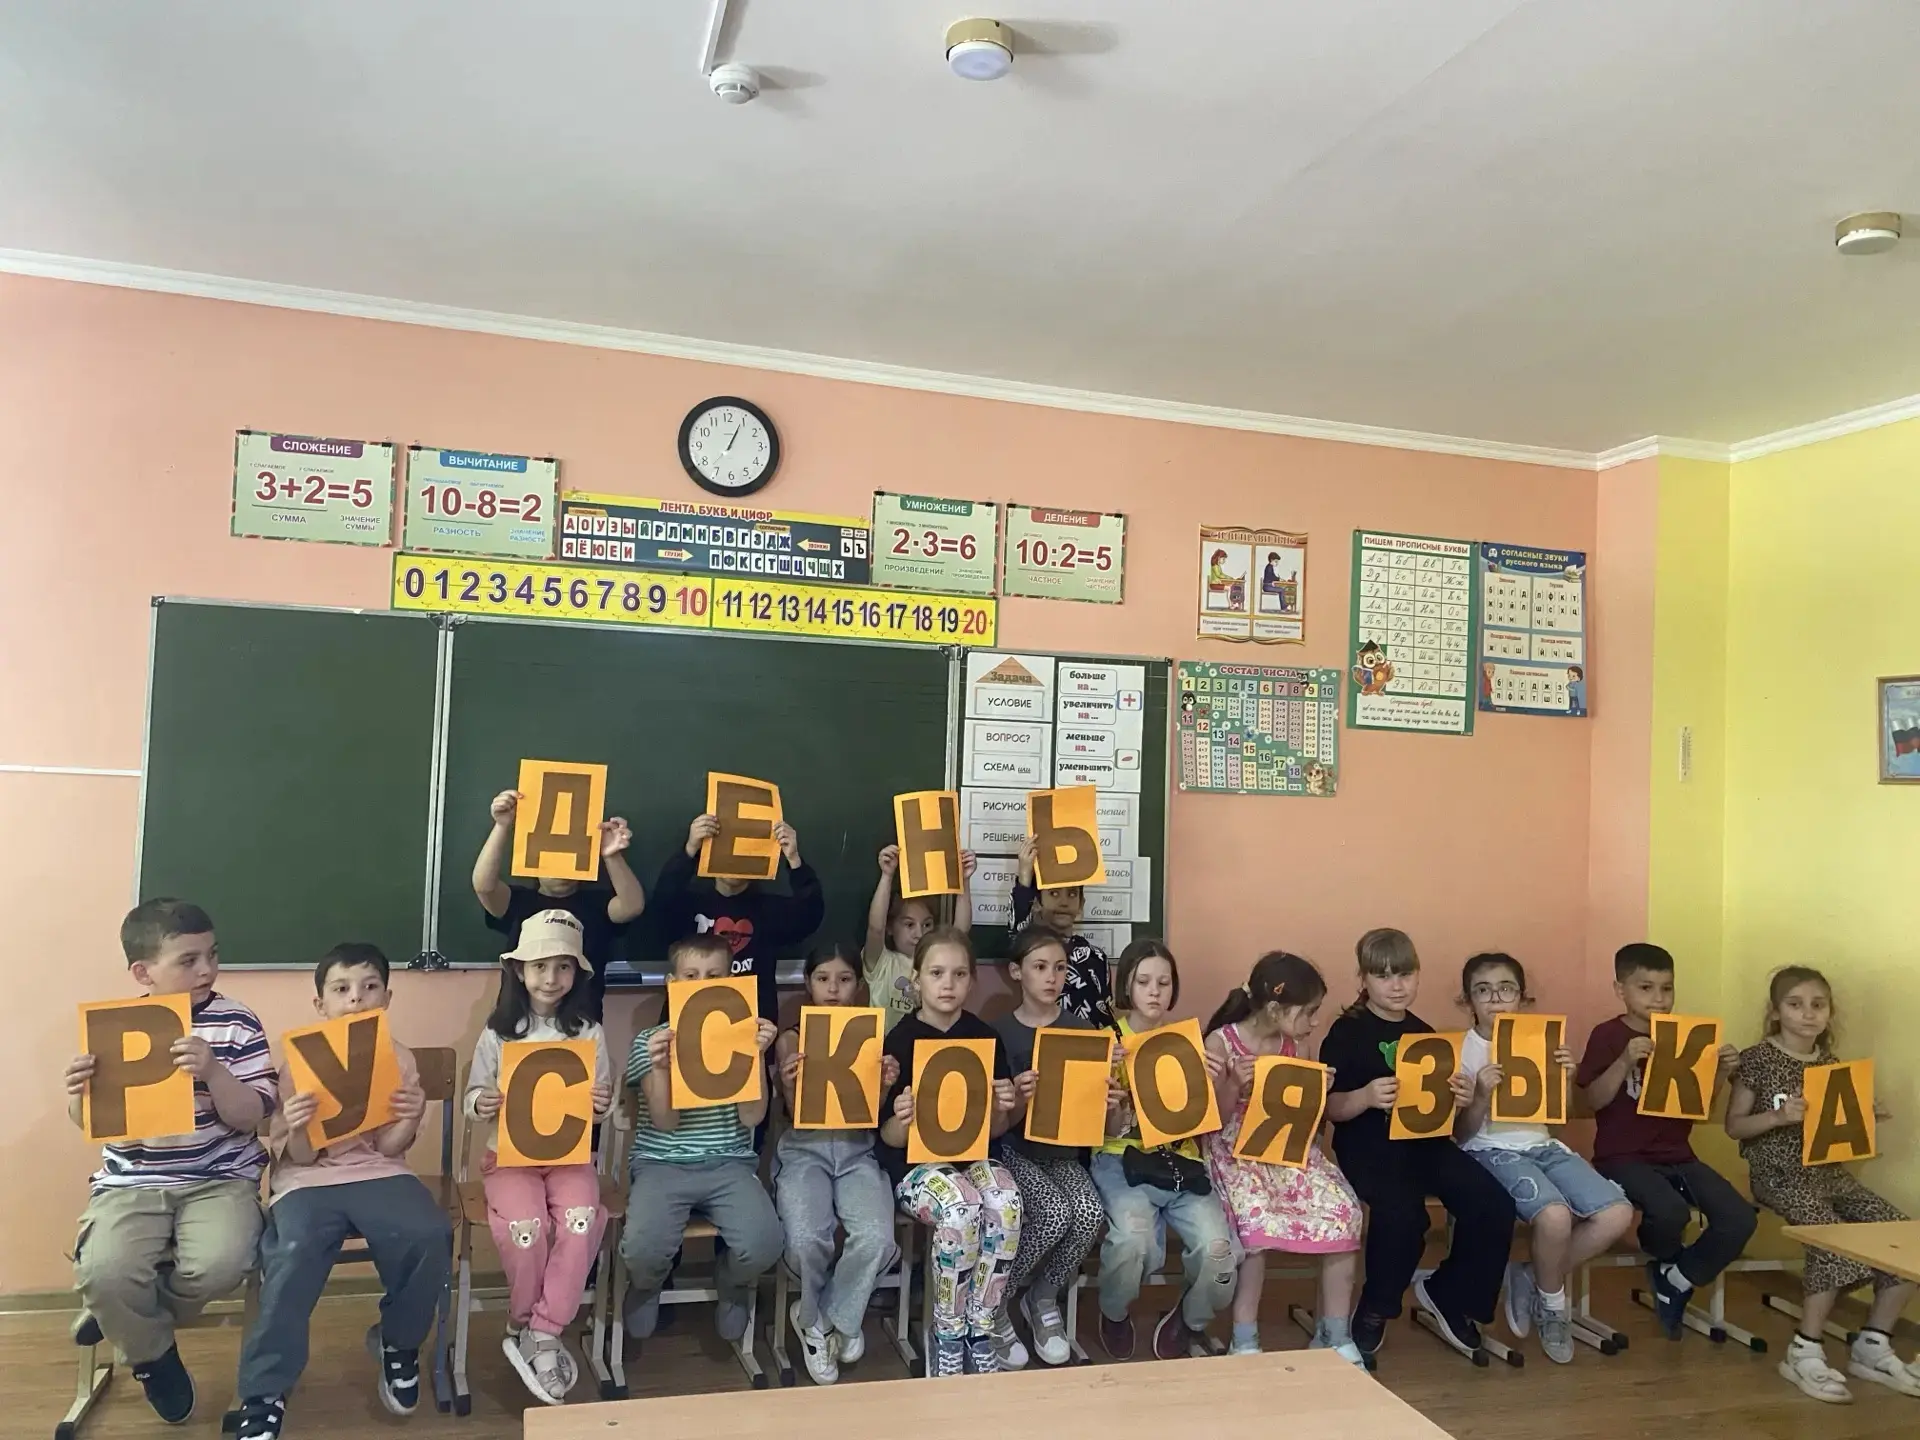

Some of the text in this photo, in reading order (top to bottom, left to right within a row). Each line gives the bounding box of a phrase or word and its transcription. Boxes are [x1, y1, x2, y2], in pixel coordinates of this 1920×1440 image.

[710, 417, 718, 427] 11
[723, 413, 733, 422] 12
[742, 418, 745, 427] 1
[700, 427, 710, 437] 10
[752, 428, 758, 437] 2
[282, 441, 352, 455] СЛОЖЕНИЕ
[696, 442, 702, 450] 9
[758, 442, 763, 451] 3
[449, 455, 518, 470] ВЫЧИТАНИЕ
[702, 456, 708, 465] 8
[753, 457, 759, 466] 4
[714, 467, 719, 476] 7
[729, 471, 734, 480] 6
[743, 467, 749, 476] 5
[256, 471, 373, 508] 3+2=5
[421, 486, 541, 522] 10-8=2
[906, 501, 967, 513] УМНОЖЕНИЕ
[660, 502, 773, 520] ЛЕНТА БУКВ И ЦИФР
[271, 514, 306, 523] СУММА
[340, 515, 381, 524] ЗНАЧЕНИЕ
[1044, 512, 1088, 525] ДЕЛЕНИЕ
[433, 526, 481, 537] РАЗНОСТЬ
[1365, 537, 1392, 546] ПИШЕМ
[1396, 541, 1441, 551] ПРОПИСНЫЕ
[1016, 539, 1111, 570] 10:2=5
[1501, 549, 1568, 562] СОГЛАСНЫЕ ЗВУКИ
[1506, 559, 1538, 567] русского
[884, 564, 944, 575] ПРОИЗВЕДЕНИЕ
[1028, 576, 1062, 585] ЧАСТНОЕ
[405, 568, 707, 616] 0 1 2 3 4 5 6 7 8 9 10
[723, 591, 987, 635] 11 12 13 14 15 16 17 18 19 20
[1070, 671, 1106, 681] больше
[1221, 667, 1297, 677] СОСТАВ ЧИСЛА
[990, 671, 1032, 684] Задача
[1185, 680, 1190, 688] 1
[1201, 681, 1207, 689] 2
[1217, 682, 1222, 690] 3
[1263, 684, 1269, 692] 6
[1279, 685, 1284, 693] 7
[1293, 686, 1299, 694] 8
[1309, 687, 1314, 695] 9
[1323, 687, 1333, 695] 10
[988, 698, 1032, 708] УСЛОВИЕ
[1063, 699, 1113, 710] увеличить
[1182, 715, 1193, 723] 11
[1198, 723, 1208, 731] 12
[986, 733, 1030, 743] ВОПРОС?
[1066, 733, 1105, 742] меньше
[1213, 730, 1224, 738] 13
[1228, 737, 1239, 745] 14
[1244, 745, 1255, 753] 15
[1260, 753, 1270, 761] 16
[984, 763, 1015, 772] СХЕМА
[1059, 762, 1112, 772] уменьшить
[1274, 760, 1285, 768] 17
[983, 802, 1026, 811] РИСУНОК
[525, 771, 1099, 892] Д Е Н Ь
[983, 833, 1025, 842] РЕШЕНИЕ
[978, 904, 1009, 912] сколь
[1091, 907, 1123, 916] больше
[87, 985, 1209, 1160] Р У С С К О Г О
[1239, 1019, 1871, 1164] Я З Ы К А
